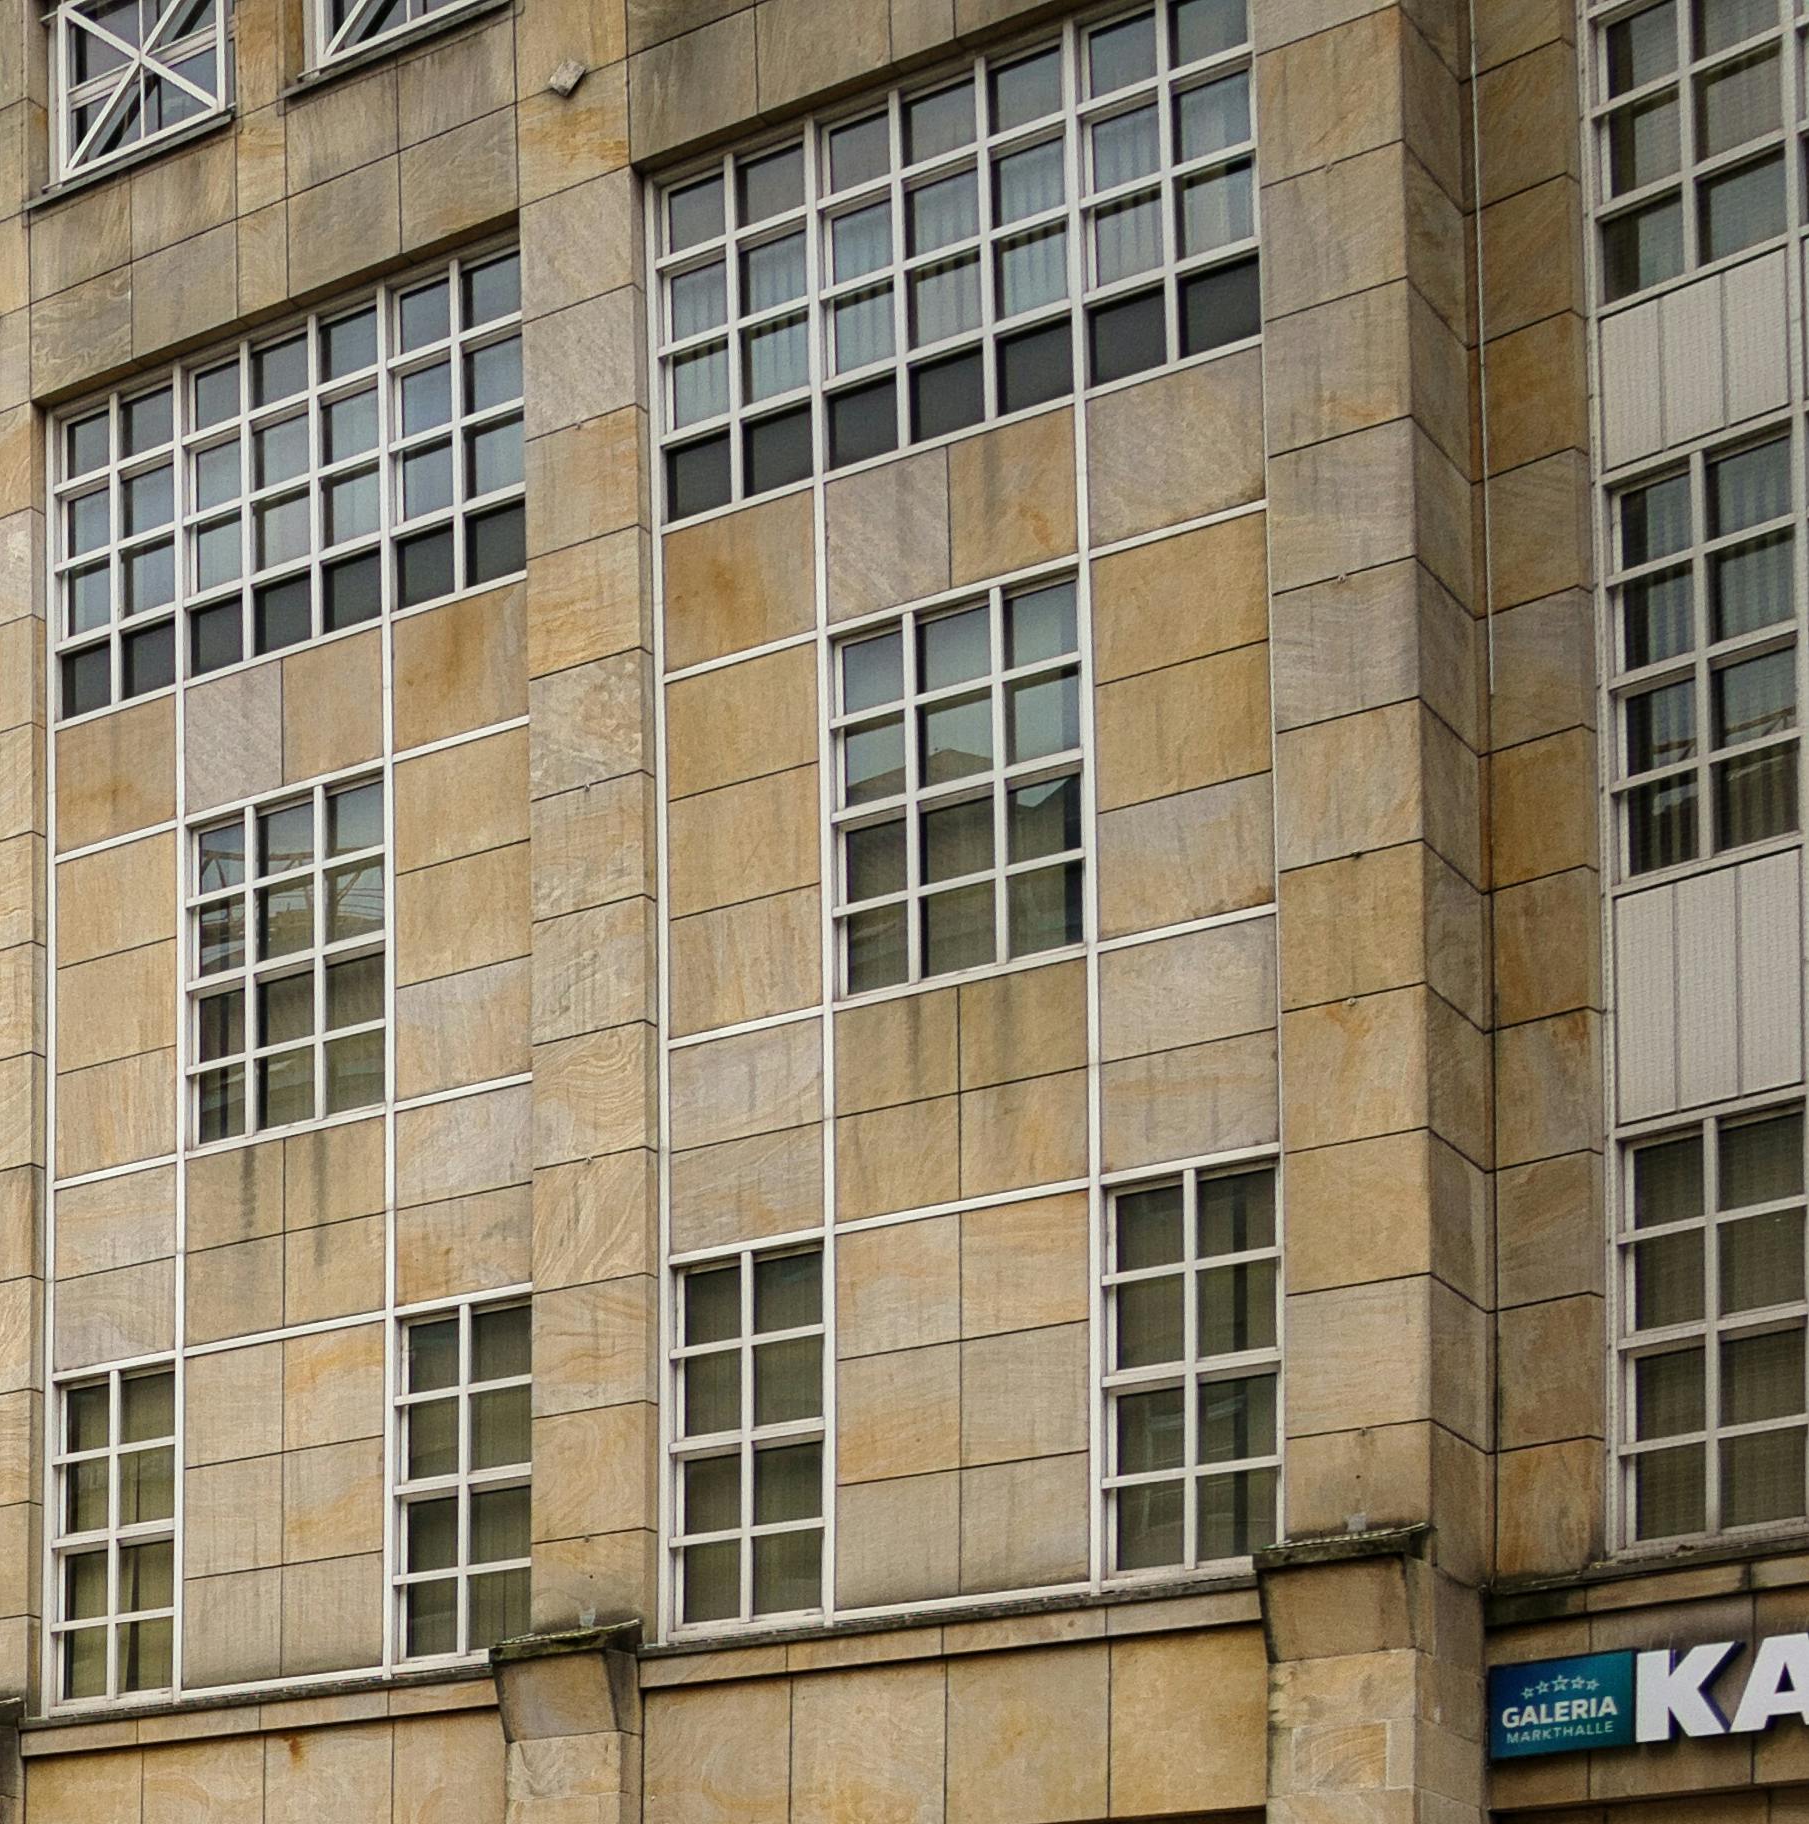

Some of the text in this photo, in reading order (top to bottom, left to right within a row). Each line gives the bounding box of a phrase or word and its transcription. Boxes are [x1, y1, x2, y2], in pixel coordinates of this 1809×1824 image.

[1635, 1632, 1809, 1744] KA
[1501, 1695, 1619, 1729] GALERIA
[1506, 1720, 1615, 1745] MARKTHALLE
